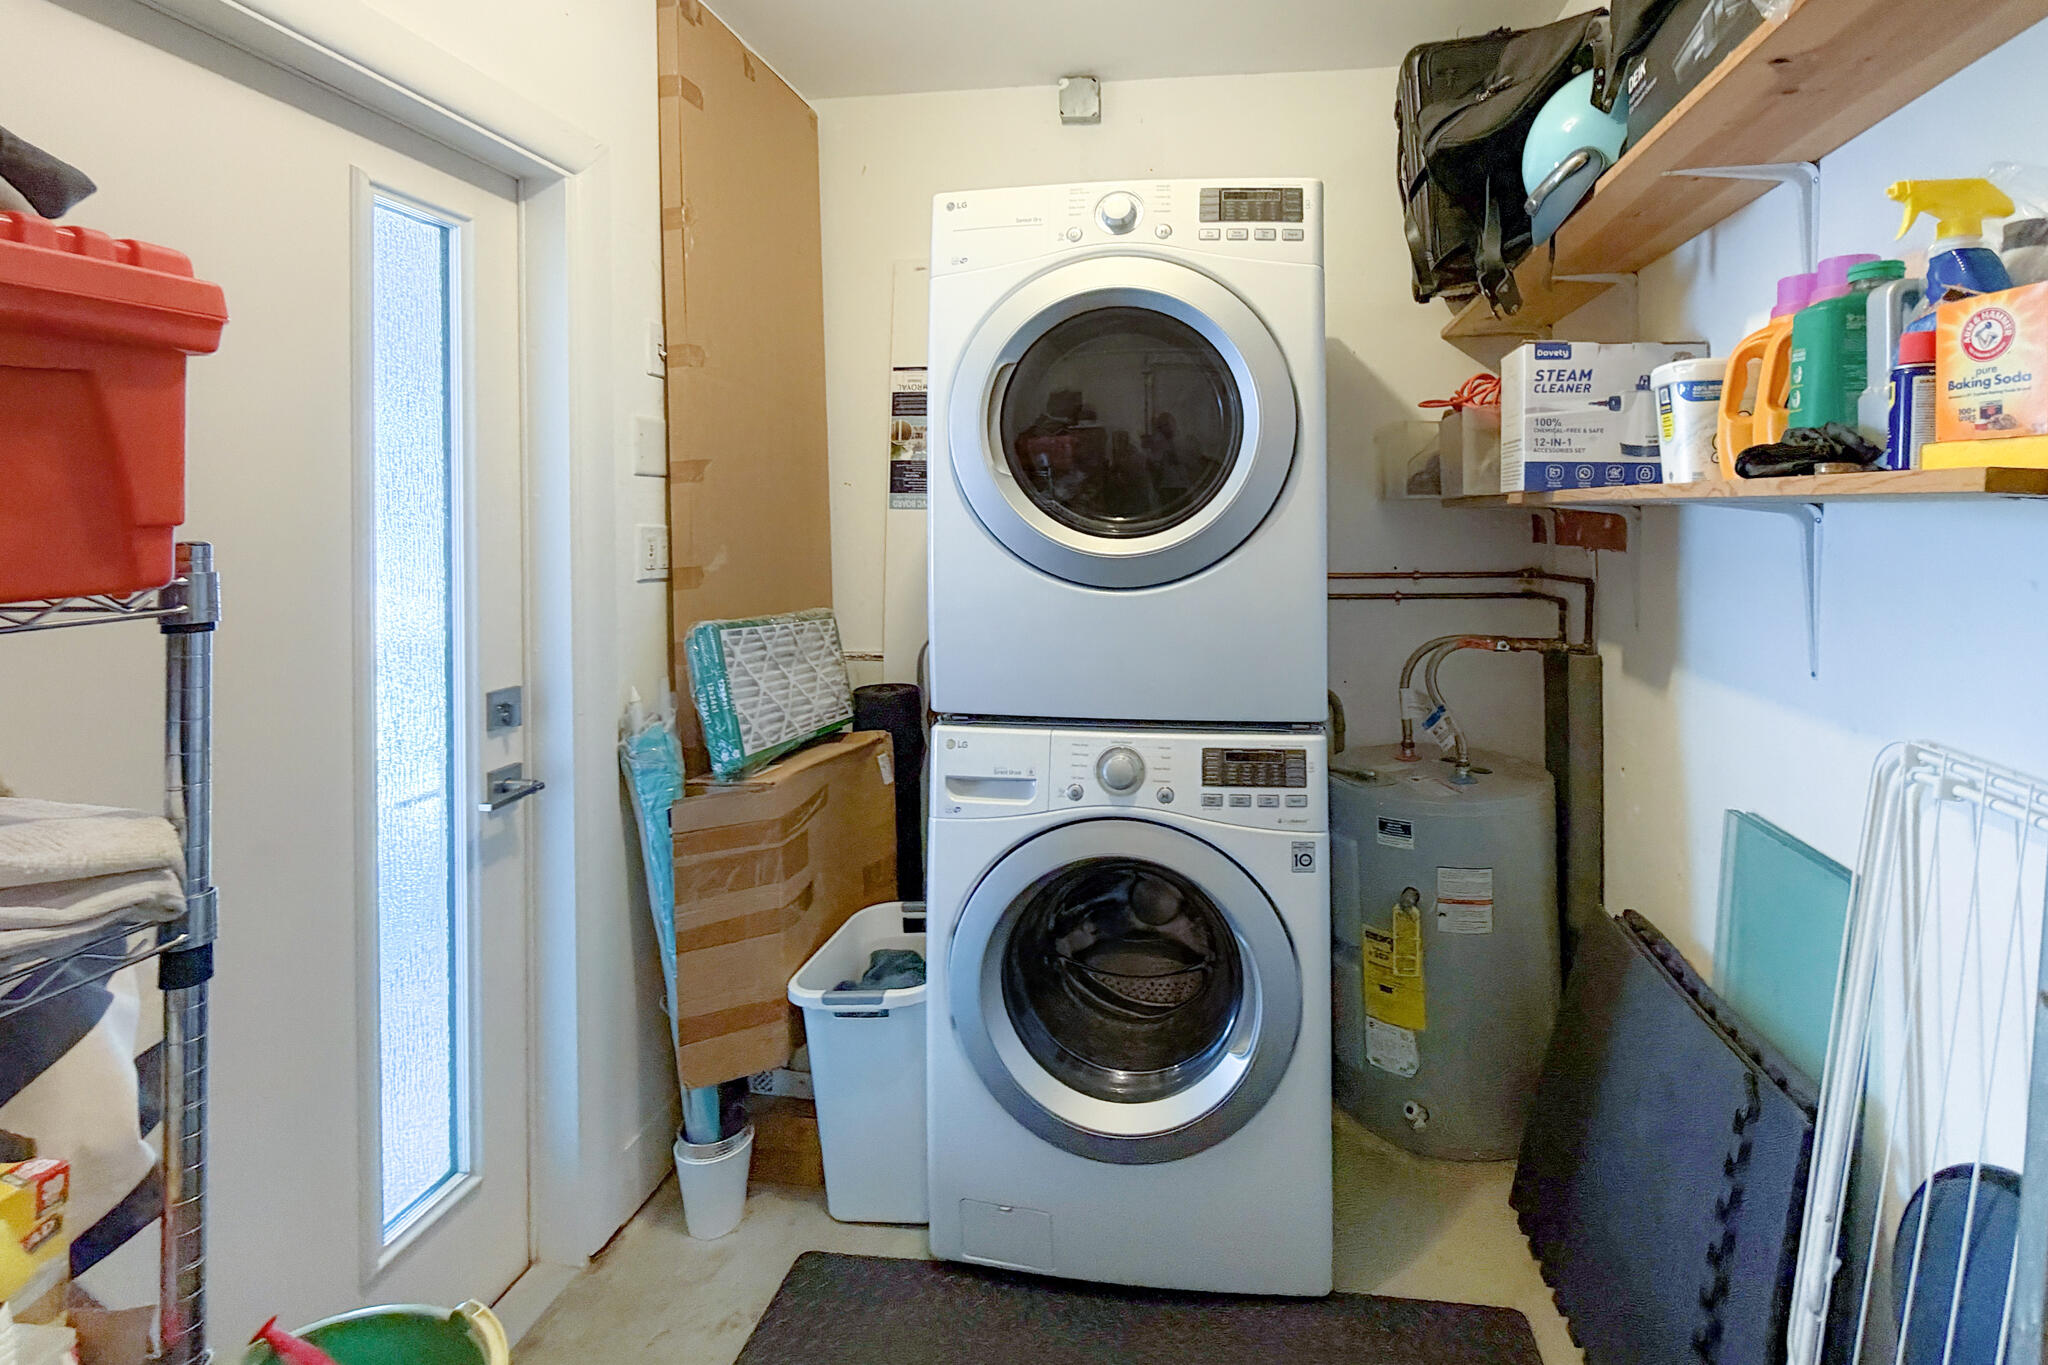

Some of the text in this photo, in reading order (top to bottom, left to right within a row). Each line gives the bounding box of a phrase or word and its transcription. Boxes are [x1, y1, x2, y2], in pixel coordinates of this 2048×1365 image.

[956, 201, 968, 209] LG
[1534, 369, 1593, 382] STEAM
[1976, 366, 1998, 377] pure
[1948, 377, 1992, 391] Baking
[1994, 371, 2032, 385] Soda
[1534, 383, 1592, 393] CLEANER
[1534, 418, 1562, 427] 100%
[1534, 438, 1572, 447] 12-IN-1
[957, 741, 968, 749] LG
